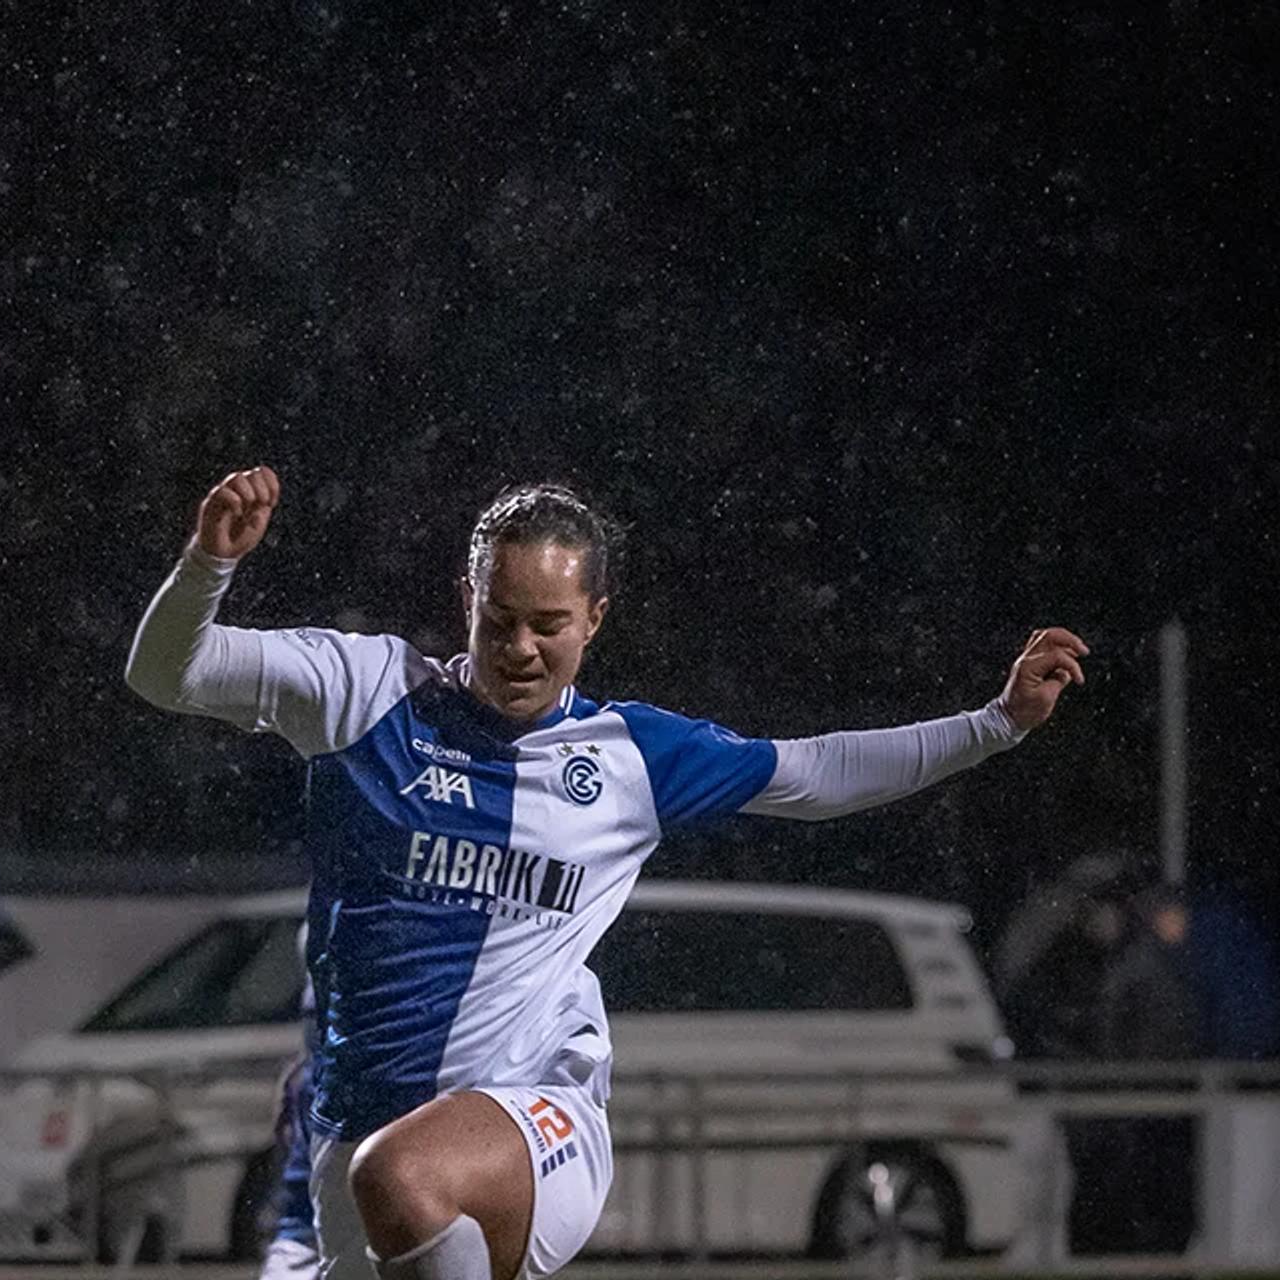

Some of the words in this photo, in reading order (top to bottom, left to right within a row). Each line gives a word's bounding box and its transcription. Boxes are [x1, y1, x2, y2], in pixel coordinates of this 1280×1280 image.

[399, 765, 476, 809] AXA
[405, 830, 542, 904] FABRIK
[527, 1095, 574, 1149] 12
